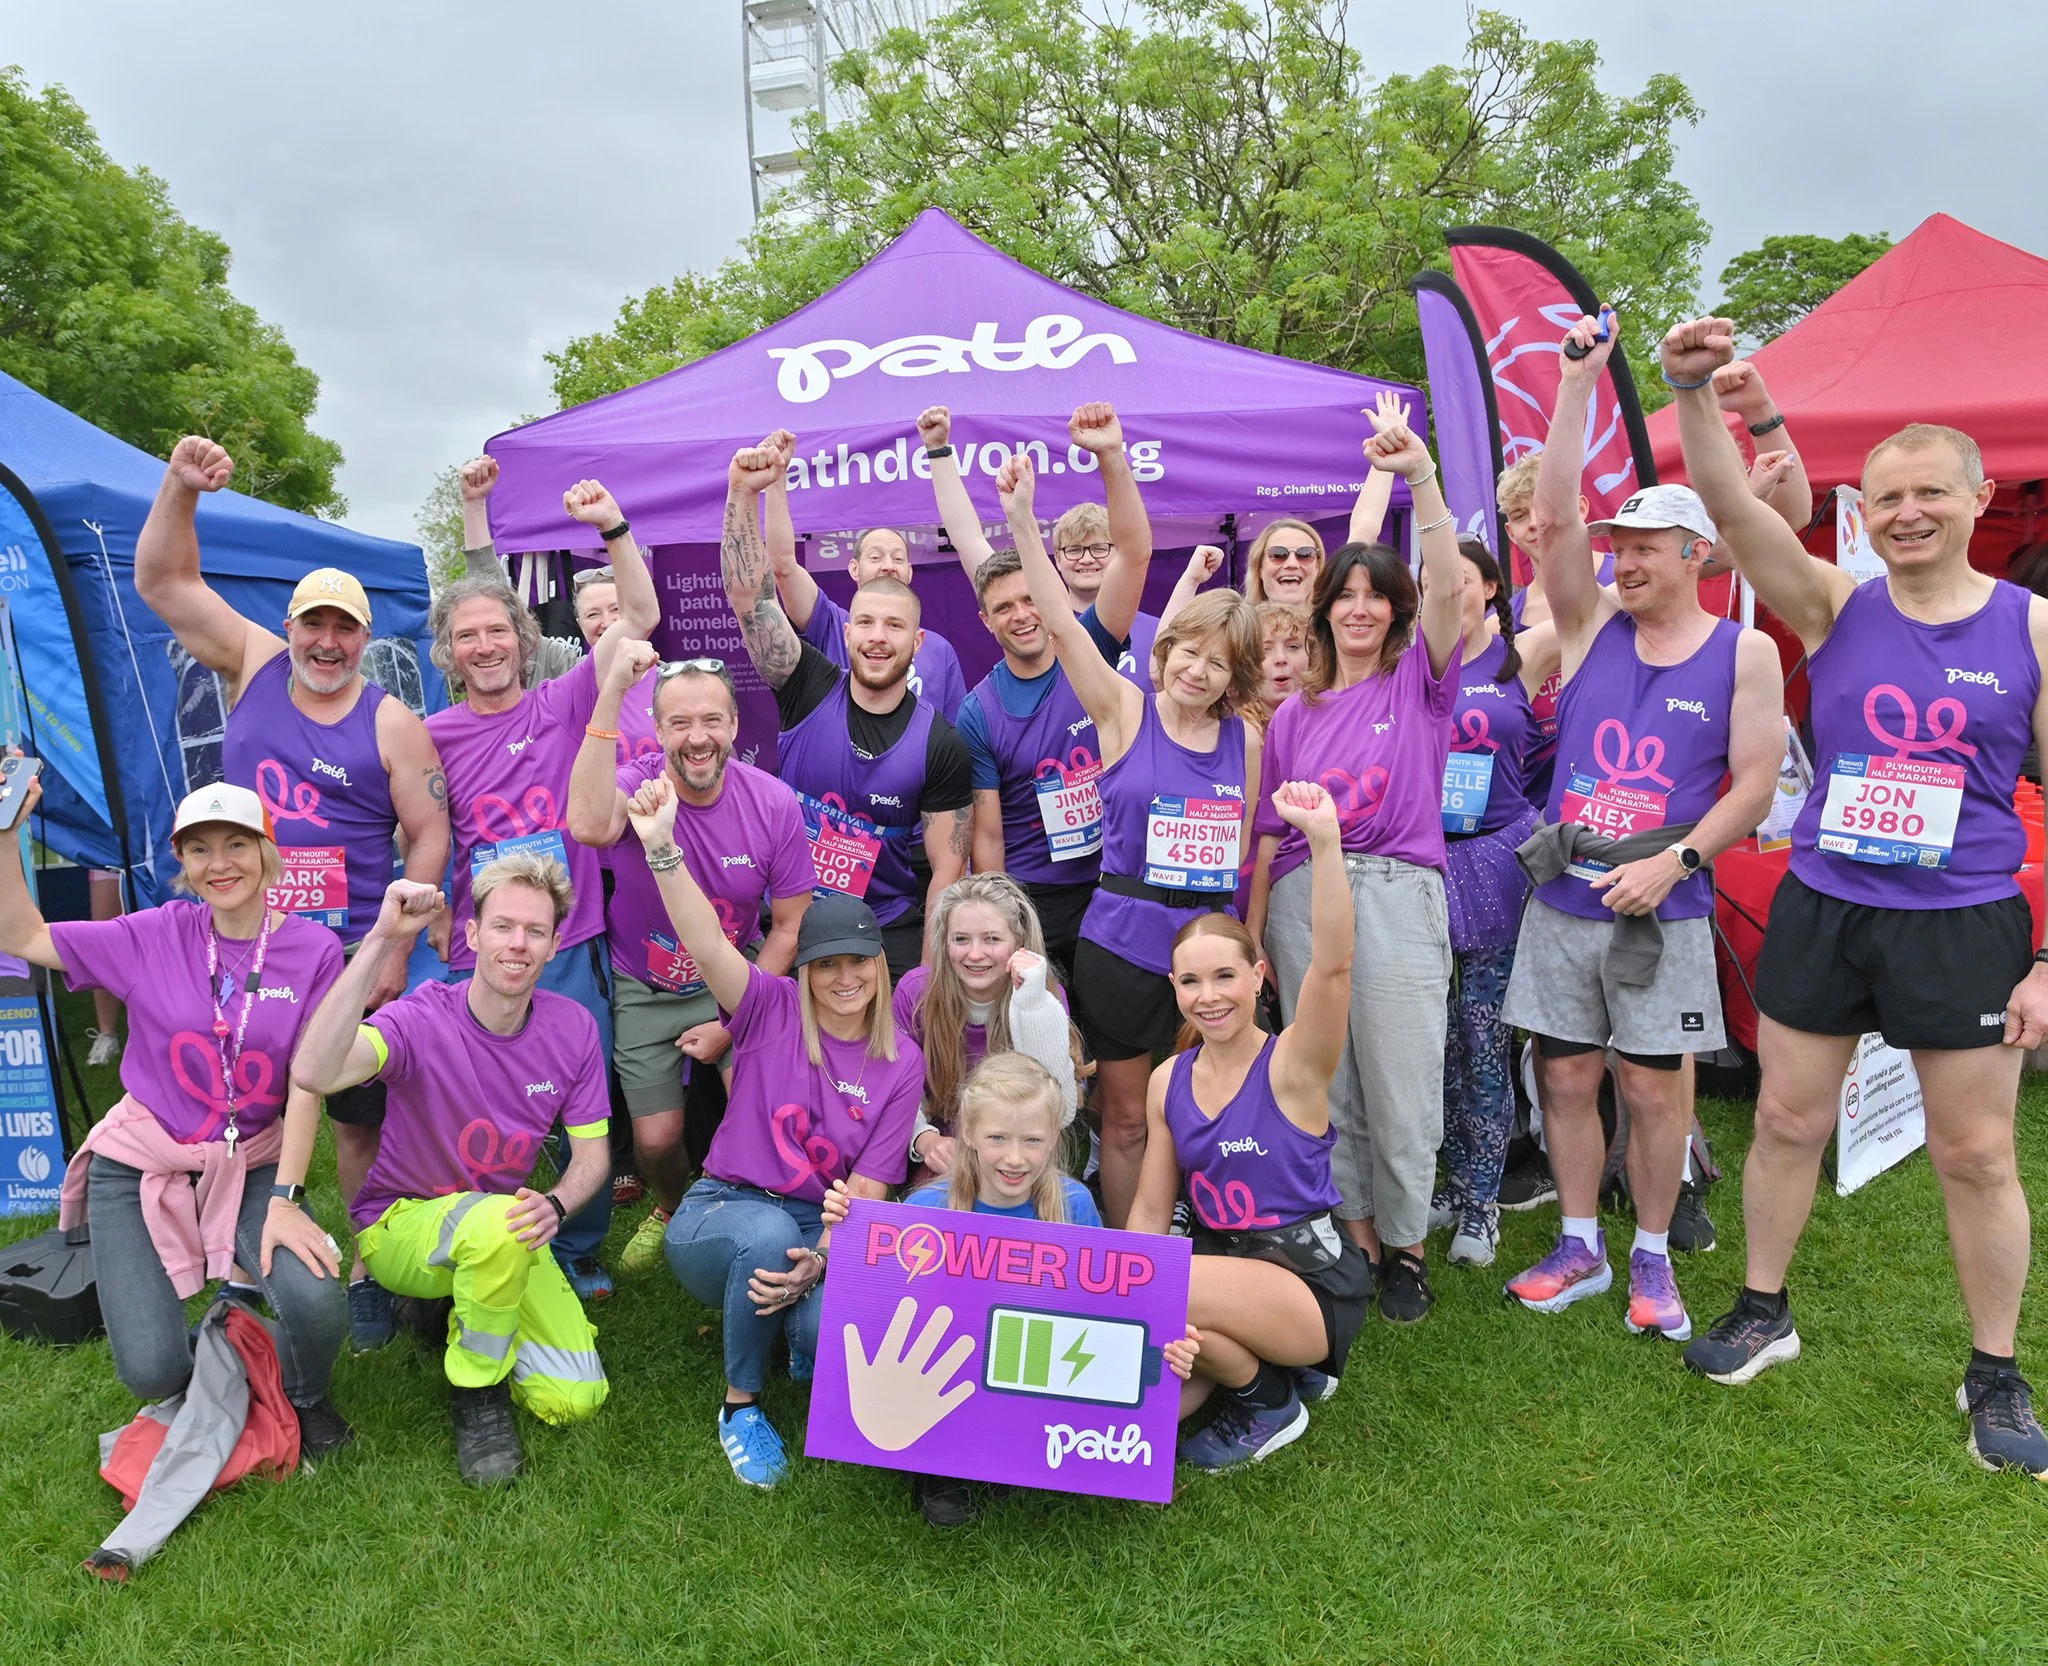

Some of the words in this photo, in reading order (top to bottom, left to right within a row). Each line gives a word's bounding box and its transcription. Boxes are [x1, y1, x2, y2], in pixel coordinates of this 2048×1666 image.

[766, 314, 1137, 403] path
[760, 437, 1165, 493] athdevon.og
[1256, 486, 1282, 497] Reg.
[1284, 484, 1325, 495] Charity
[1328, 484, 1347, 493] No.
[680, 593, 723, 613] path
[669, 614, 740, 631] homele
[682, 637, 701, 651] to
[1945, 667, 2008, 694] path
[1462, 683, 1506, 698] path
[1665, 698, 1710, 722] path
[1067, 715, 1094, 737] pat
[312, 758, 352, 787] path
[1472, 760, 1486, 768] 10K
[1885, 762, 1942, 775] PLYMOUTH
[1067, 777, 1083, 787] HALF
[1871, 769, 1894, 778] HALF
[1896, 772, 1956, 786] MARATHON
[869, 793, 903, 808] path
[1597, 792, 1615, 801] HALF
[1616, 797, 1660, 811] MARATHON
[1610, 787, 1650, 801] PLYMOUTH
[1855, 783, 1917, 809] JON
[1189, 810, 1209, 818] HALF
[1578, 801, 1636, 830] ALEX
[1842, 805, 1925, 837] 5980
[1152, 820, 1237, 842] CHRISTINA
[504, 840, 541, 853] PLYMOUTH
[543, 836, 555, 845] 10K
[821, 838, 837, 847] HALF
[838, 842, 873, 857] MARATHON
[832, 836, 865, 849] PLYMOUTH
[1054, 837, 1074, 846] WAVE
[1822, 838, 1846, 849] WAVE
[720, 855, 756, 869] path
[809, 843, 860, 872] LLIOT
[1167, 843, 1225, 865] 4560
[1151, 872, 1175, 881] WAVE
[266, 889, 326, 908] 5729
[257, 986, 299, 1004] path
[1980, 1016, 2000, 1026] RUN
[525, 1080, 558, 1097] path
[1863, 1081, 1888, 1101] counselling
[1888, 1073, 1905, 1087] session
[1847, 1092, 1858, 1106] £25
[1879, 1104, 1889, 1115] help
[1895, 1097, 1905, 1106] care
[5, 1112, 54, 1137] LIVES
[1859, 1131, 1867, 1142] and
[1867, 1122, 1885, 1137] families
[1885, 1115, 1896, 1126] when
[1896, 1110, 1906, 1120] they
[1907, 1101, 1919, 1113] need
[1878, 1130, 1893, 1144] Thank
[1218, 1136, 1268, 1157] path
[7, 1183, 62, 1199] Livewe
[865, 1222, 1068, 1290] POWER
[1077, 1247, 1154, 1297] UP
[1044, 1423, 1152, 1469] path
